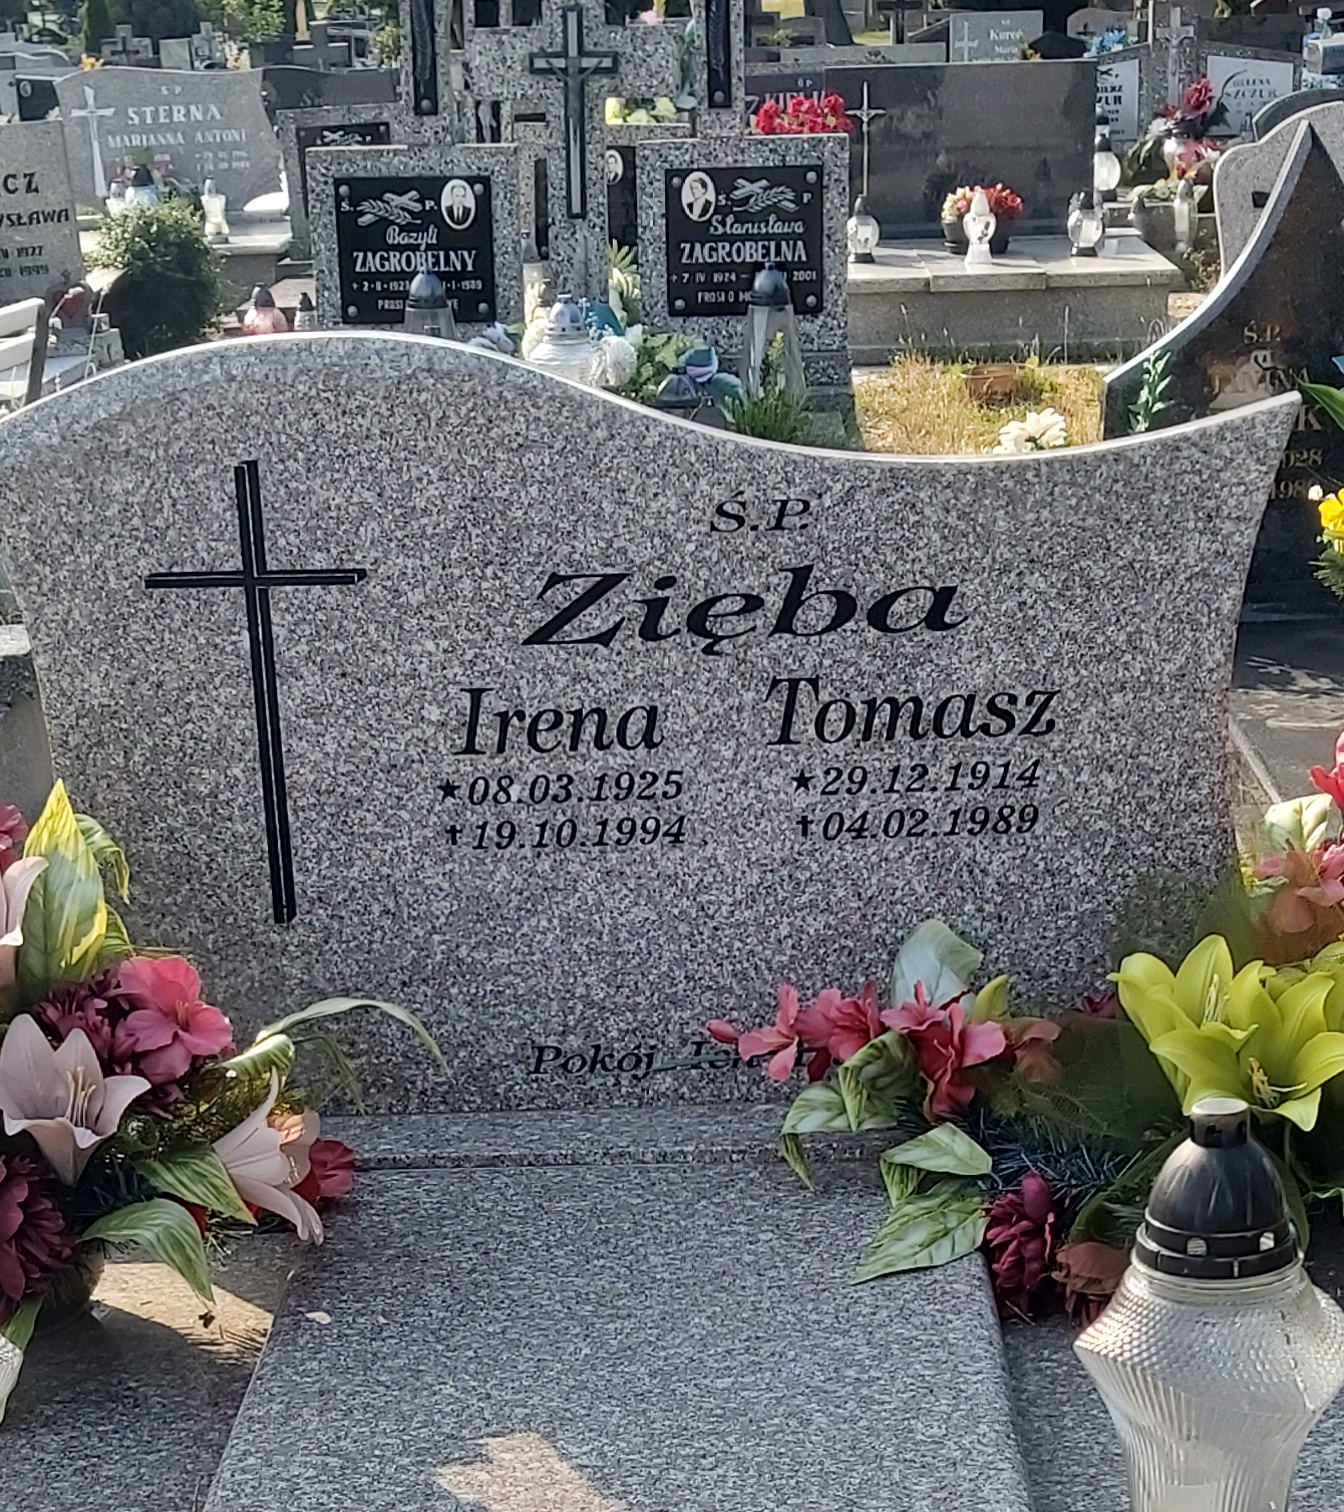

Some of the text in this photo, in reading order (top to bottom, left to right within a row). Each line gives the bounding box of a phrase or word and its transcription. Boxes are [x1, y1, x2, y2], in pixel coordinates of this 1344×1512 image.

[127, 103, 223, 125] STERNA
[386, 224, 439, 251] Bazyli
[709, 213, 805, 235] Stanisława
[353, 250, 477, 273] ZAGROBELNY
[680, 239, 807, 264] ZAGROBELNA
[710, 490, 812, 533] Ś.P.
[520, 563, 969, 656] Zięba
[454, 674, 1061, 756] Irena Tomasz
[467, 758, 1041, 806] 08.03.1925 29.12.1914
[471, 804, 1039, 850] 19.10.1994 04.02.1989
[529, 1044, 659, 1082] Pokój
